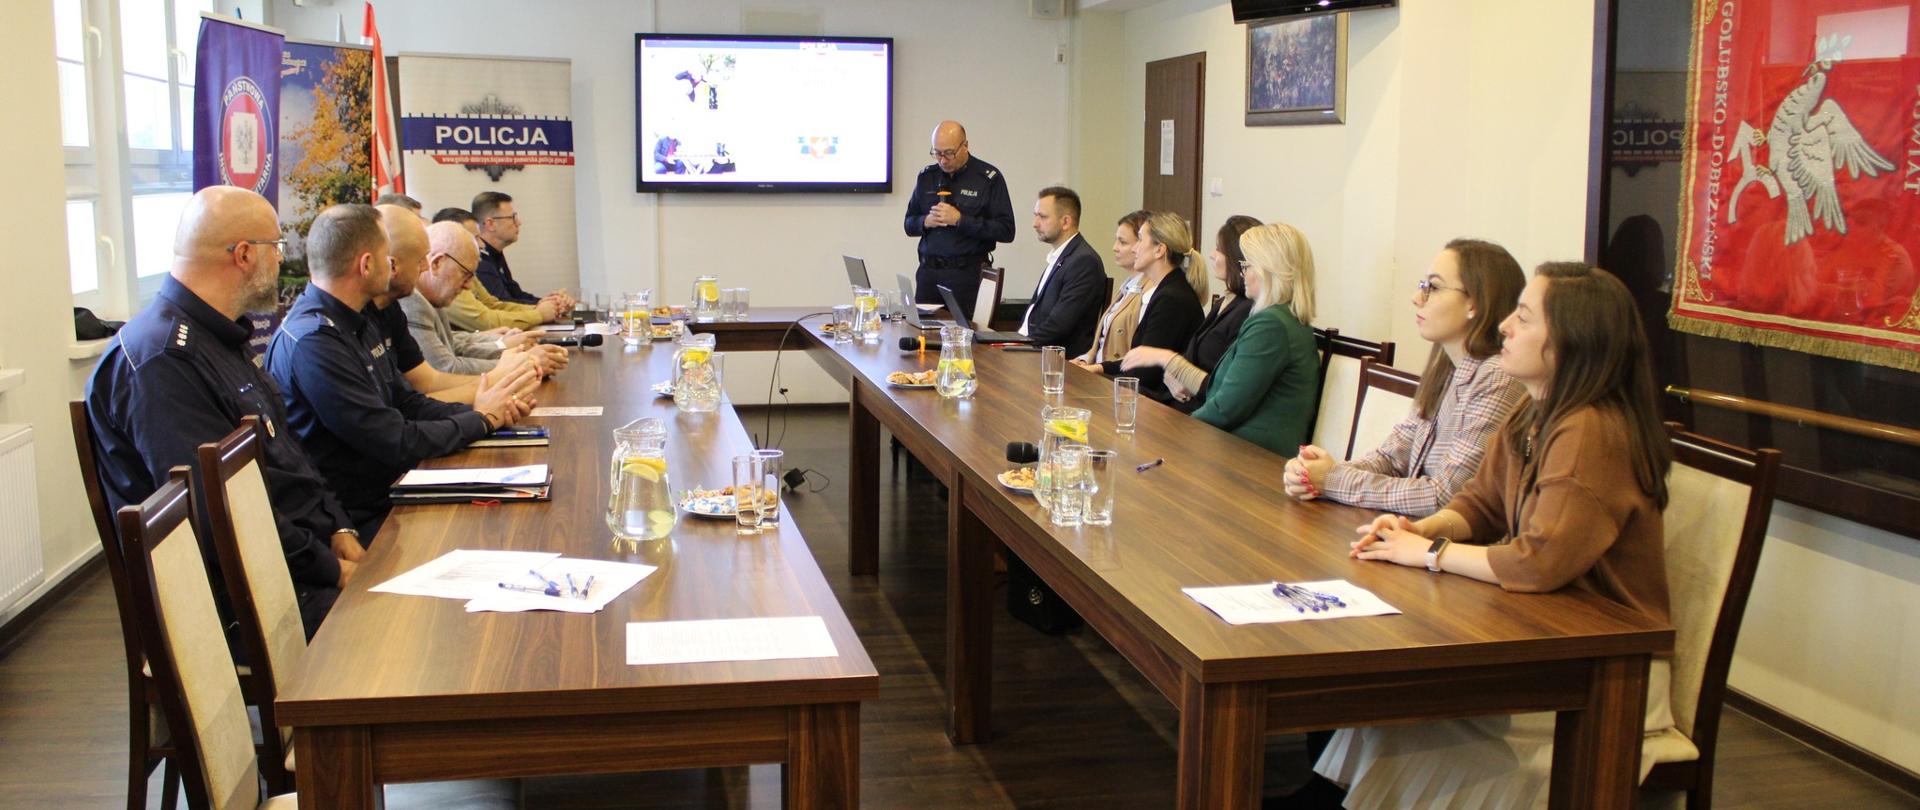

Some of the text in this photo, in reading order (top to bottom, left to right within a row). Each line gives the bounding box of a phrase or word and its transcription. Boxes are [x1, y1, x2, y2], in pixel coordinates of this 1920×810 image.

[435, 125, 549, 145] POLICJA
[1700, 1, 1734, 281] GOLUBSKO-DOBRZYŃSKI
[960, 189, 977, 197] POLICJA
